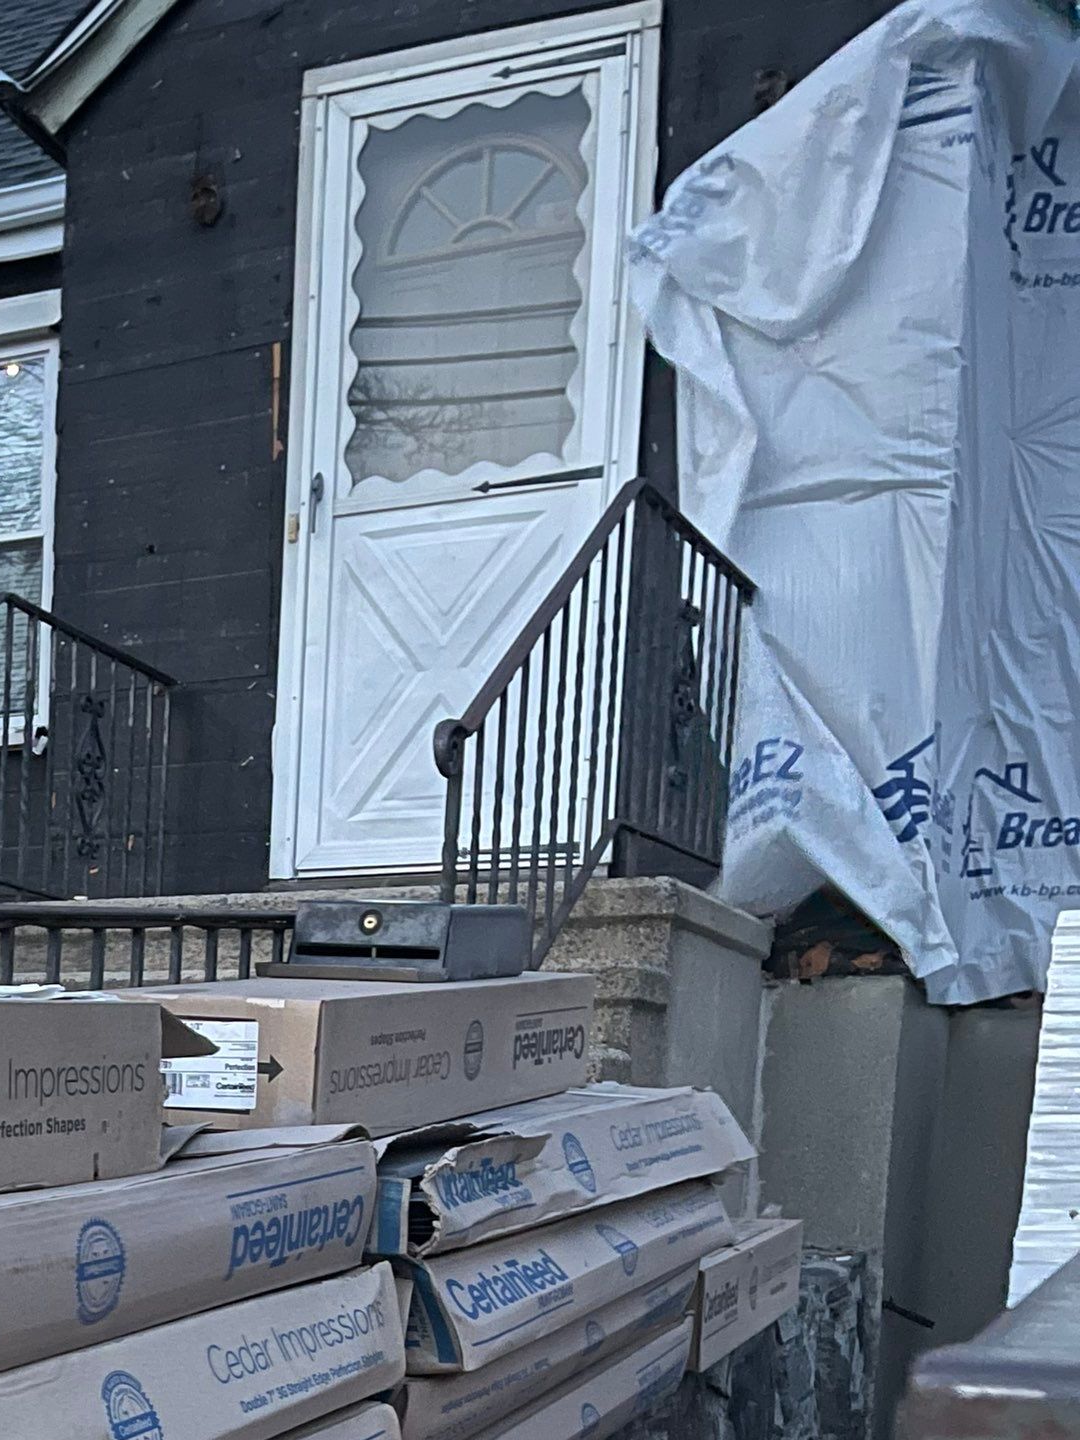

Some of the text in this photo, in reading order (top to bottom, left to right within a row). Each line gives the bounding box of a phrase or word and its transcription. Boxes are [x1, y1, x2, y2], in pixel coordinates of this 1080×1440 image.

[512, 1024, 585, 1070] CertainTeed
[7, 1055, 146, 1106] Impressions
[46, 1116, 87, 1136] Shapes
[223, 1195, 365, 1282] CertainTeed
[445, 1249, 569, 1321] CertainTeed
[207, 1334, 275, 1385] Cedar
